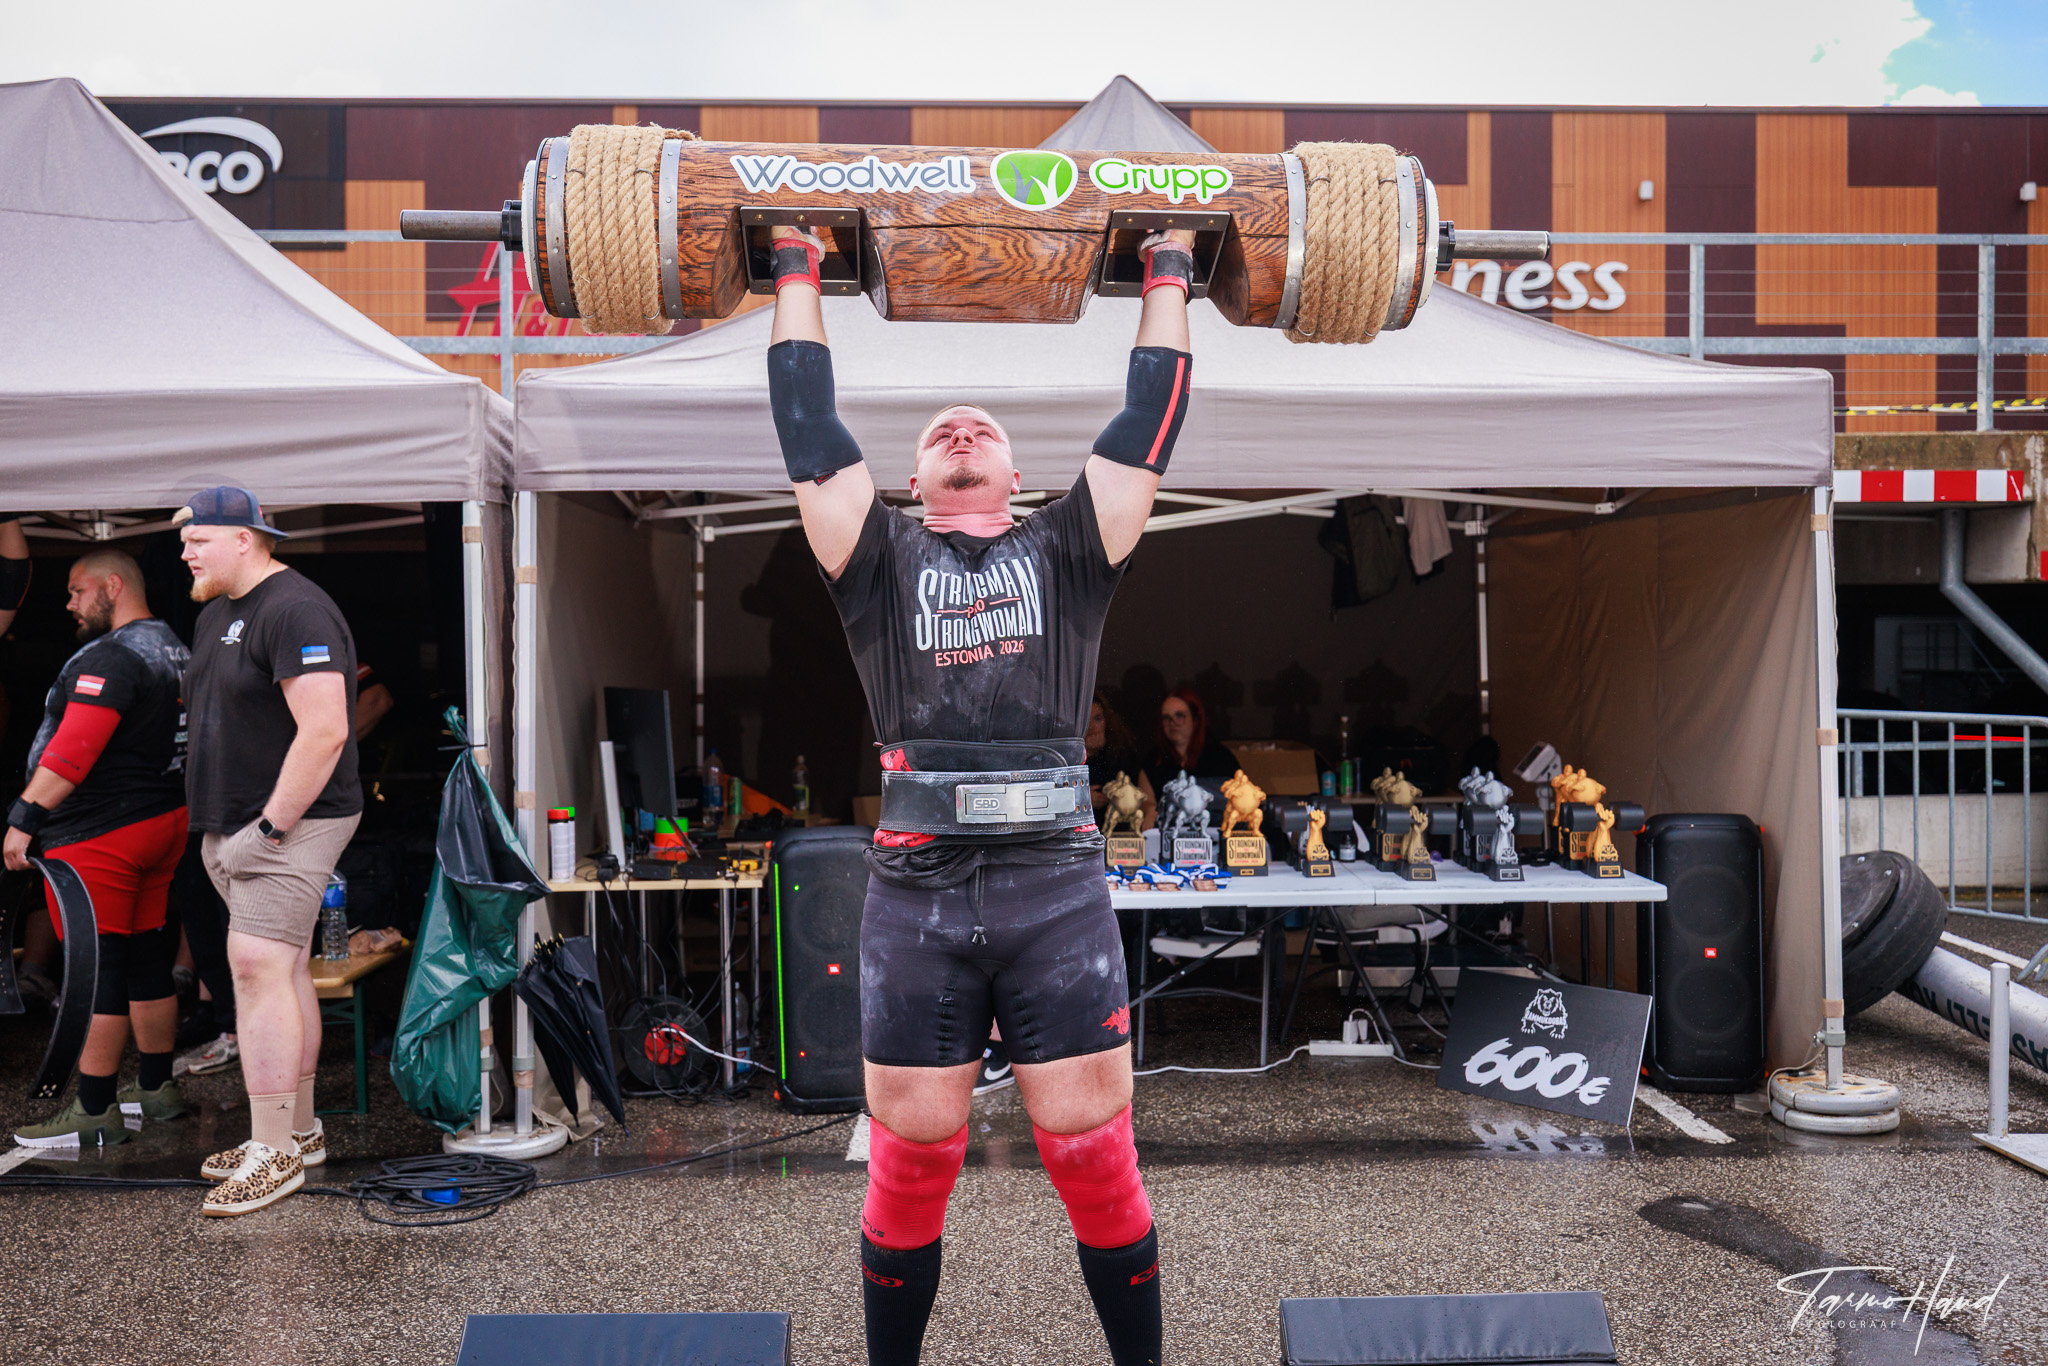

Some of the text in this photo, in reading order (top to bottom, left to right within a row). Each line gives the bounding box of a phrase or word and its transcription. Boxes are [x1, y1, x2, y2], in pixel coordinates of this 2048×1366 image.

[736, 158, 1228, 199] Woodwell Grupp
[916, 601, 1042, 651] STRONGWOMAN
[935, 640, 1025, 667] ESTONIA 2026
[974, 799, 999, 810] SBD
[1462, 1037, 1611, 1107] 600€
